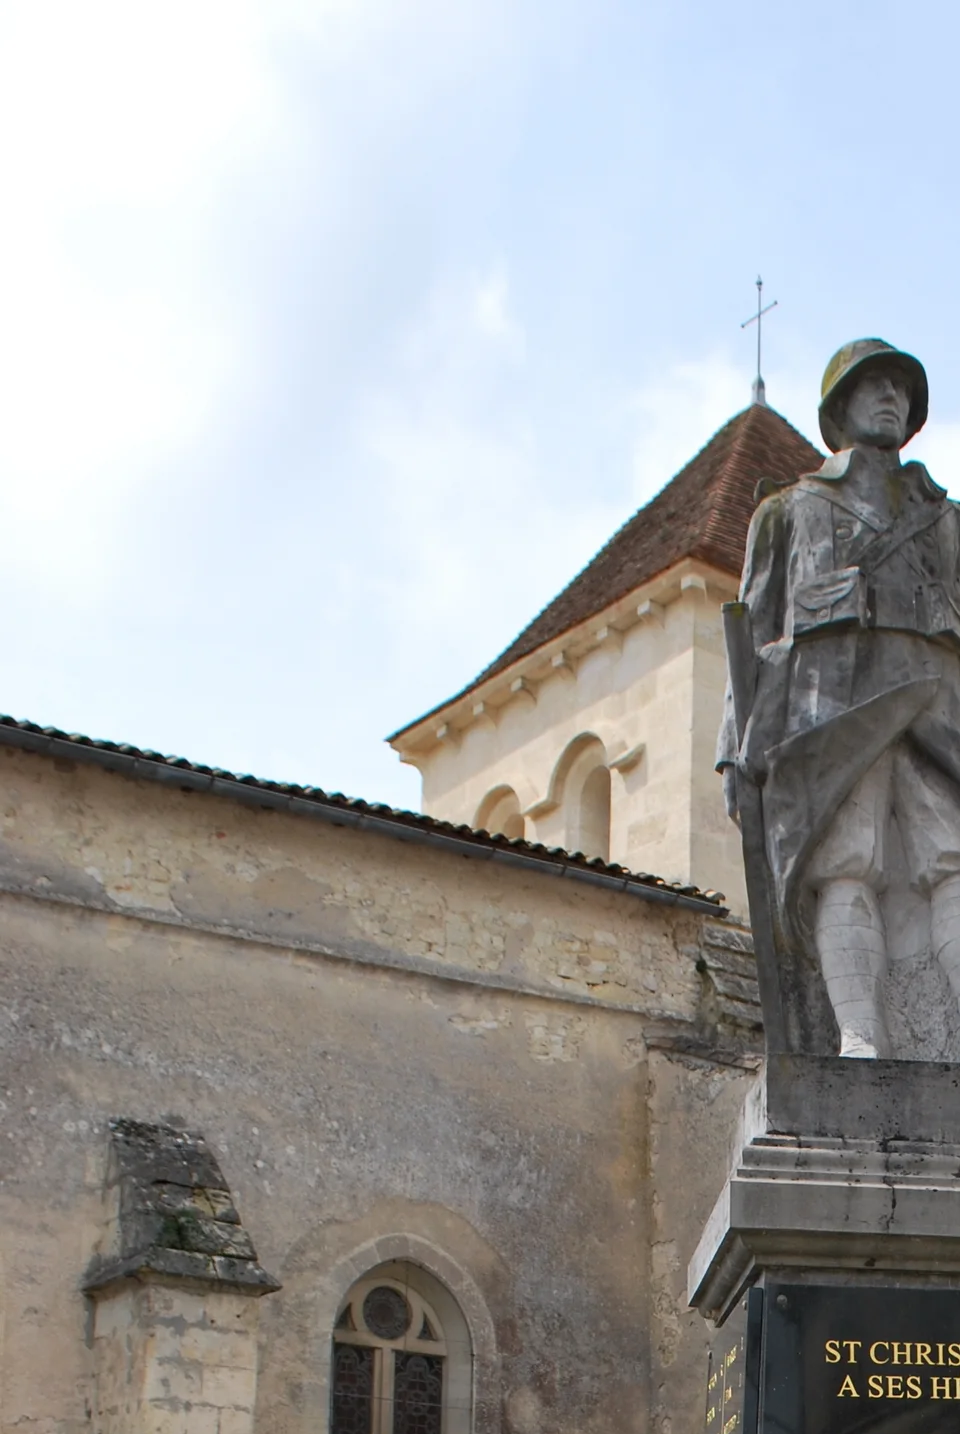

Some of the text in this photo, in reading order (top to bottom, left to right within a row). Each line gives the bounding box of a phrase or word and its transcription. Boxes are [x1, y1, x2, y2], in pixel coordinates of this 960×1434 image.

[824, 1340, 862, 1364] ST
[836, 1375, 860, 1398] A
[867, 1375, 923, 1400] SES
